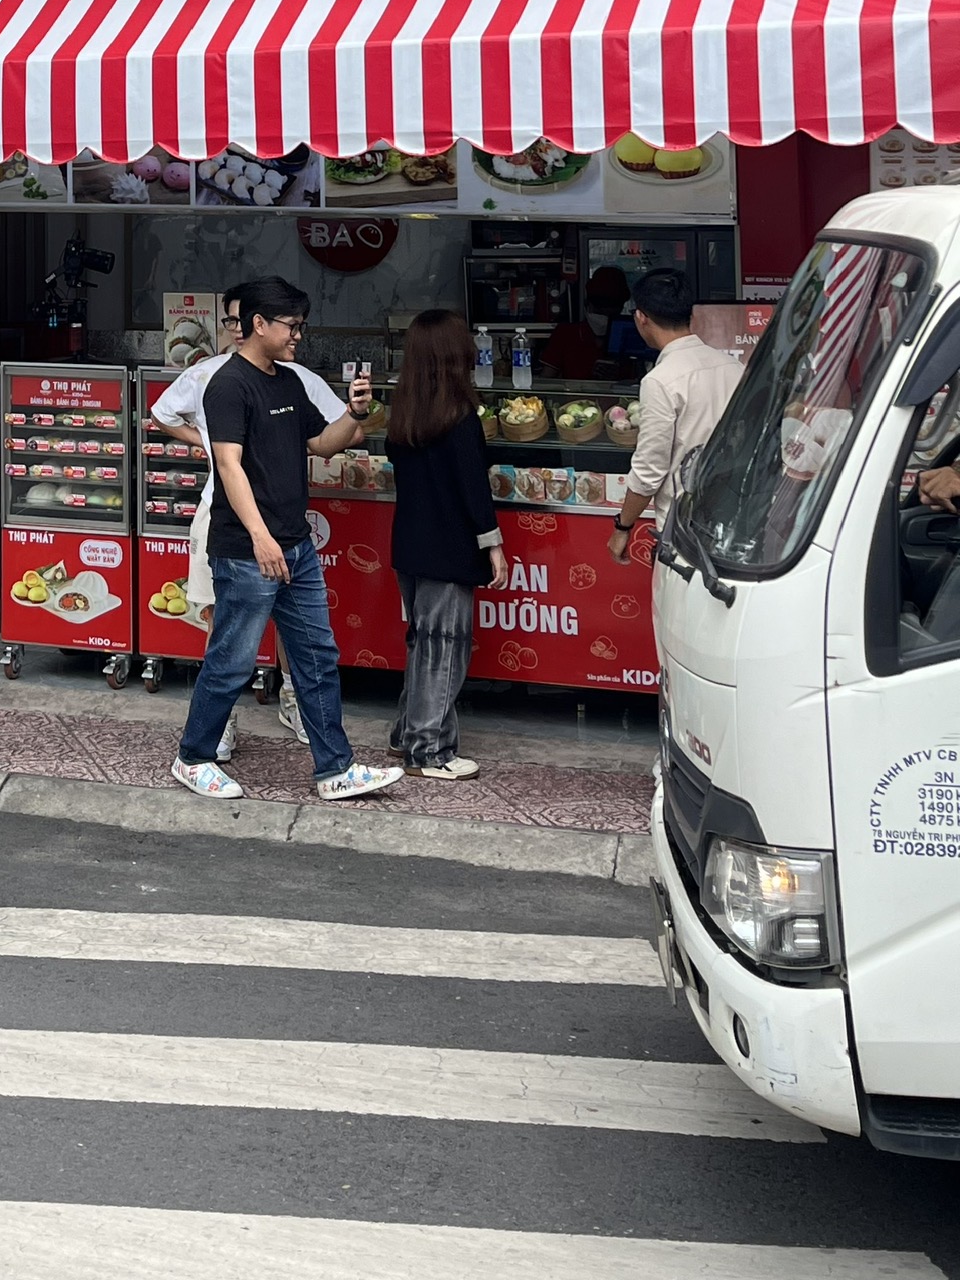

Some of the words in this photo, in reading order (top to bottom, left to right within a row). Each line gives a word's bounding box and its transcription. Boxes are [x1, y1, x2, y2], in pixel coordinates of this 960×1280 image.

[53, 381, 69, 393] THỌ
[71, 380, 91, 392] PHÁT
[8, 531, 27, 545] THỌ
[30, 531, 54, 544] PHÁT
[145, 541, 164, 555] THỌ
[479, 597, 579, 635] DƯỠNG
[88, 636, 110, 647] KIDO
[903, 749, 932, 767] MTV
[937, 749, 957, 761] CB
[874, 763, 903, 796] TNHH
[918, 788, 953, 801] 3190
[870, 798, 882, 827] CTY
[919, 801, 954, 813] 1490
[918, 814, 954, 826] 4875
[928, 832, 943, 841] TRI
[873, 839, 960, 858] ĐT:02839
